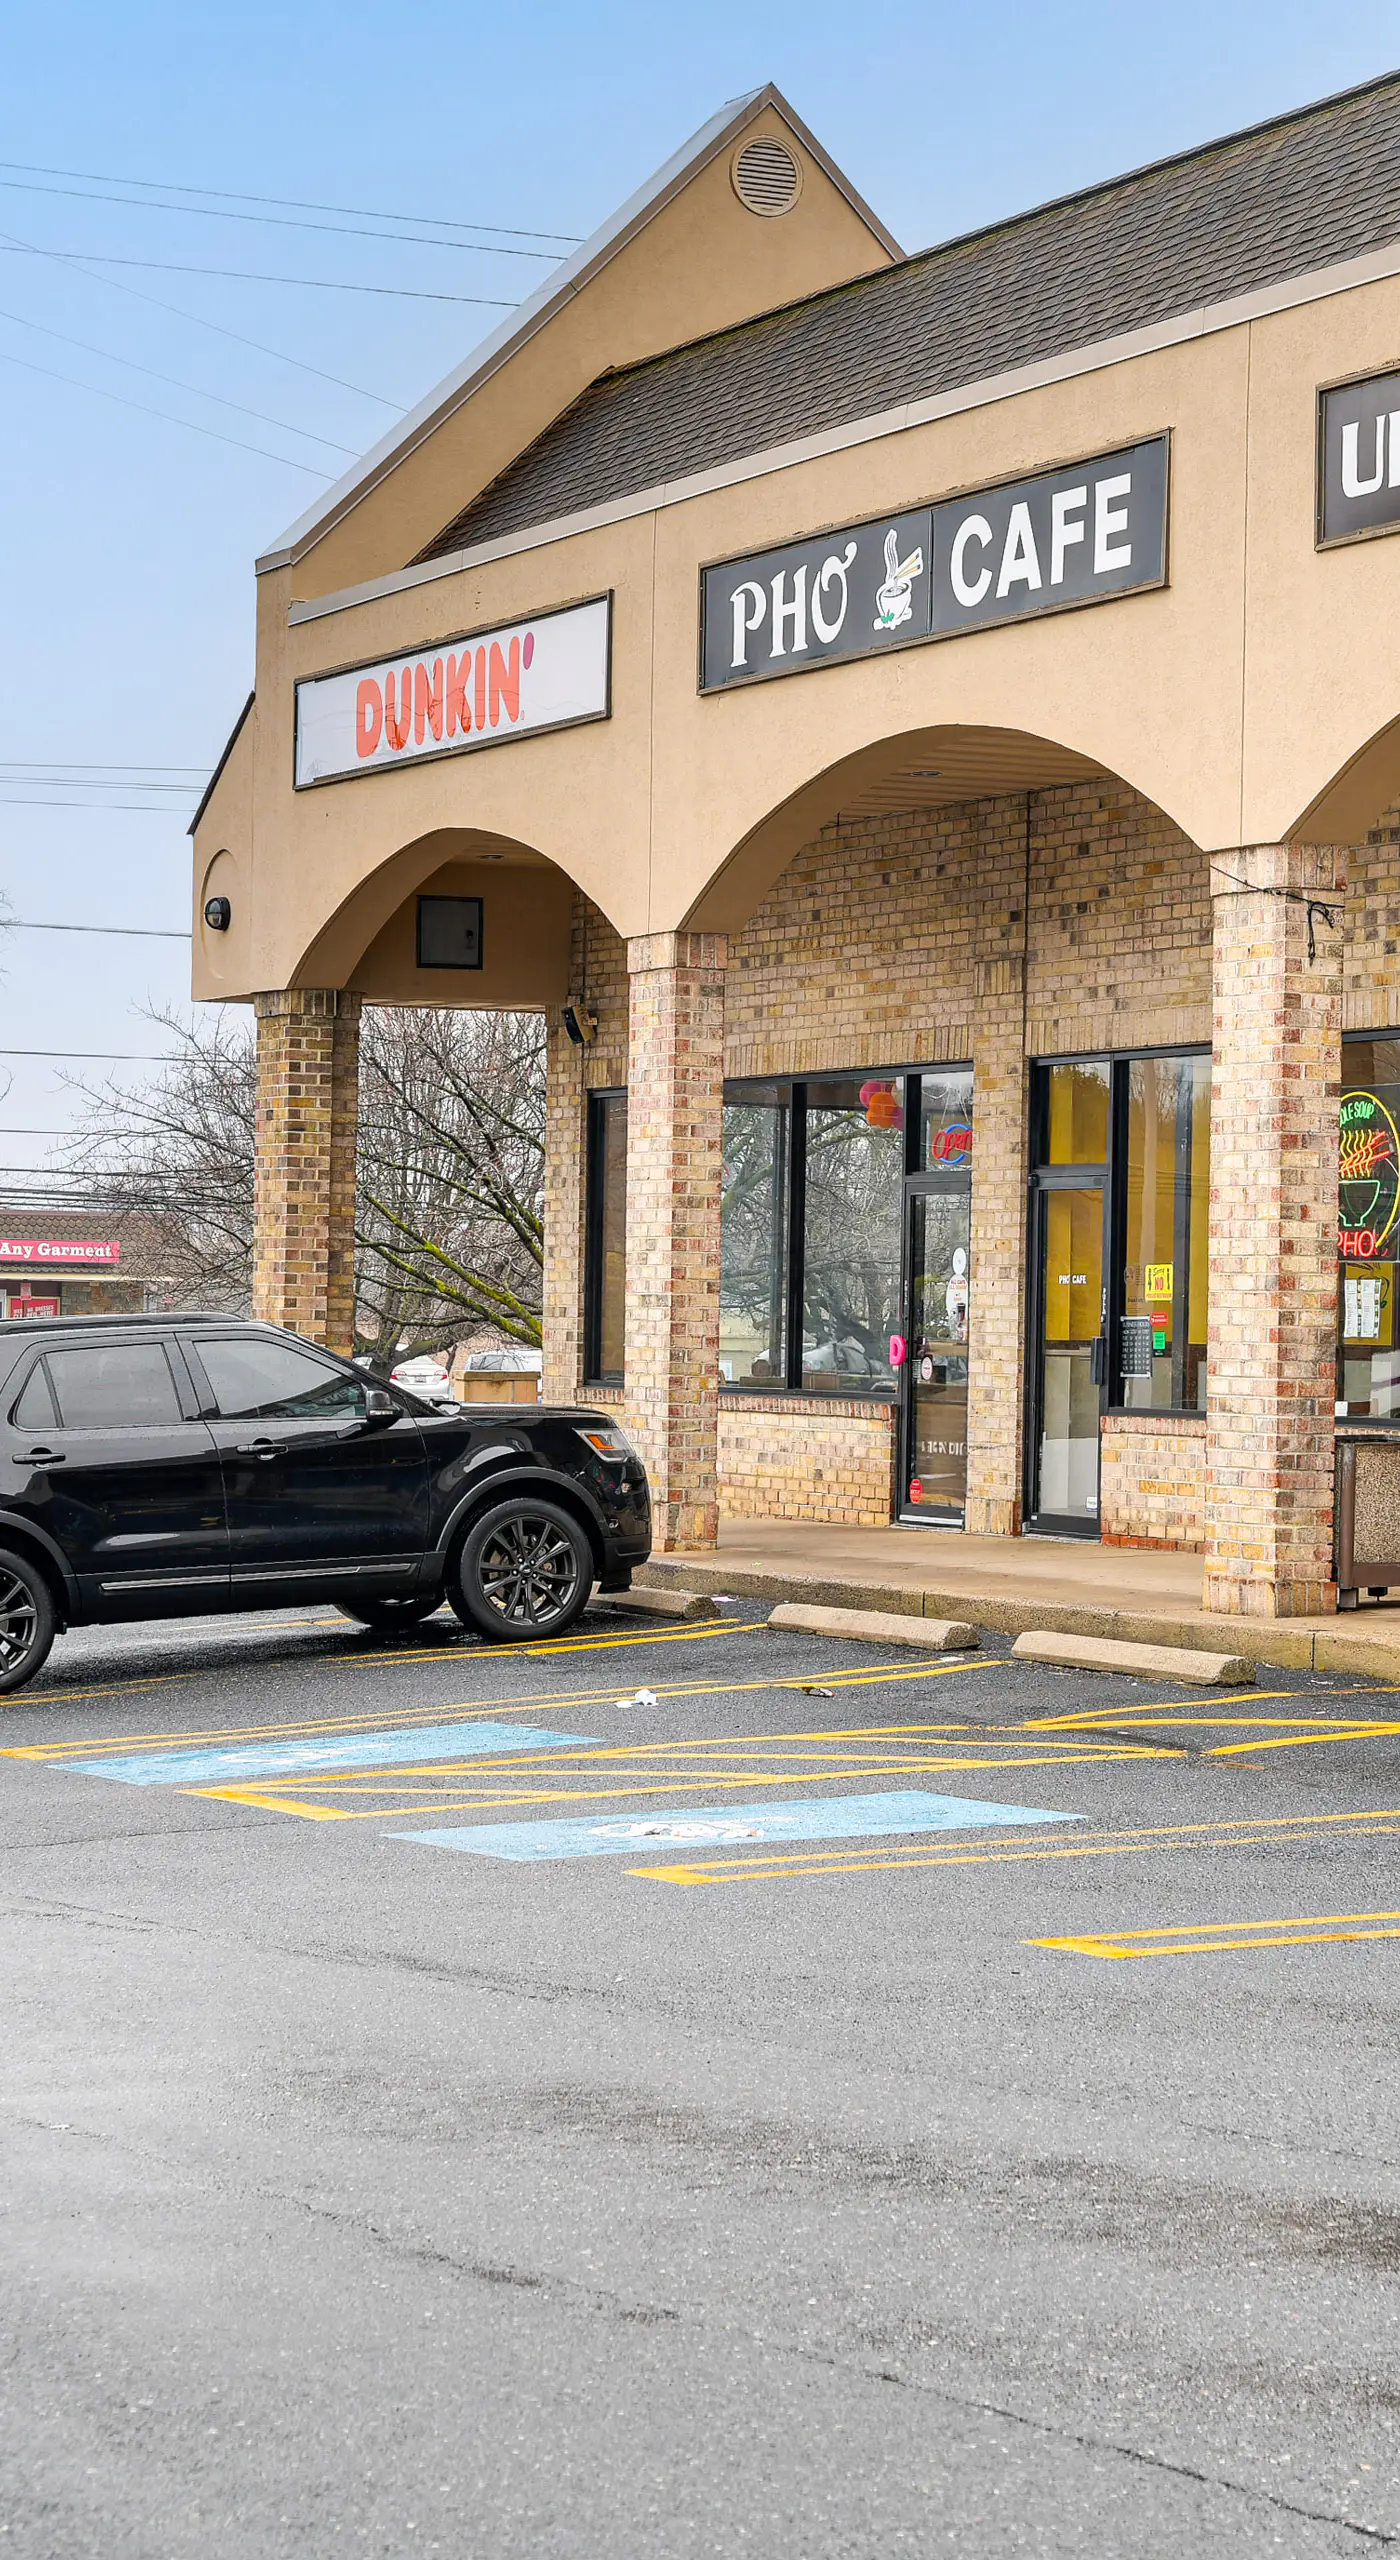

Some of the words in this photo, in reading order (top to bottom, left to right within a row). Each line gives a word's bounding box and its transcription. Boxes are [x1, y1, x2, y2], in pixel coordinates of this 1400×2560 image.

[950, 473, 1132, 607] CAFE
[356, 632, 535, 757] DUNKIN'
[1354, 1101, 1374, 1119] SOUP
[0, 1242, 34, 1259] Any
[37, 1242, 114, 1258] Garment
[1072, 1274, 1087, 1284] CAFE
[1155, 1276, 1164, 1290] NO
